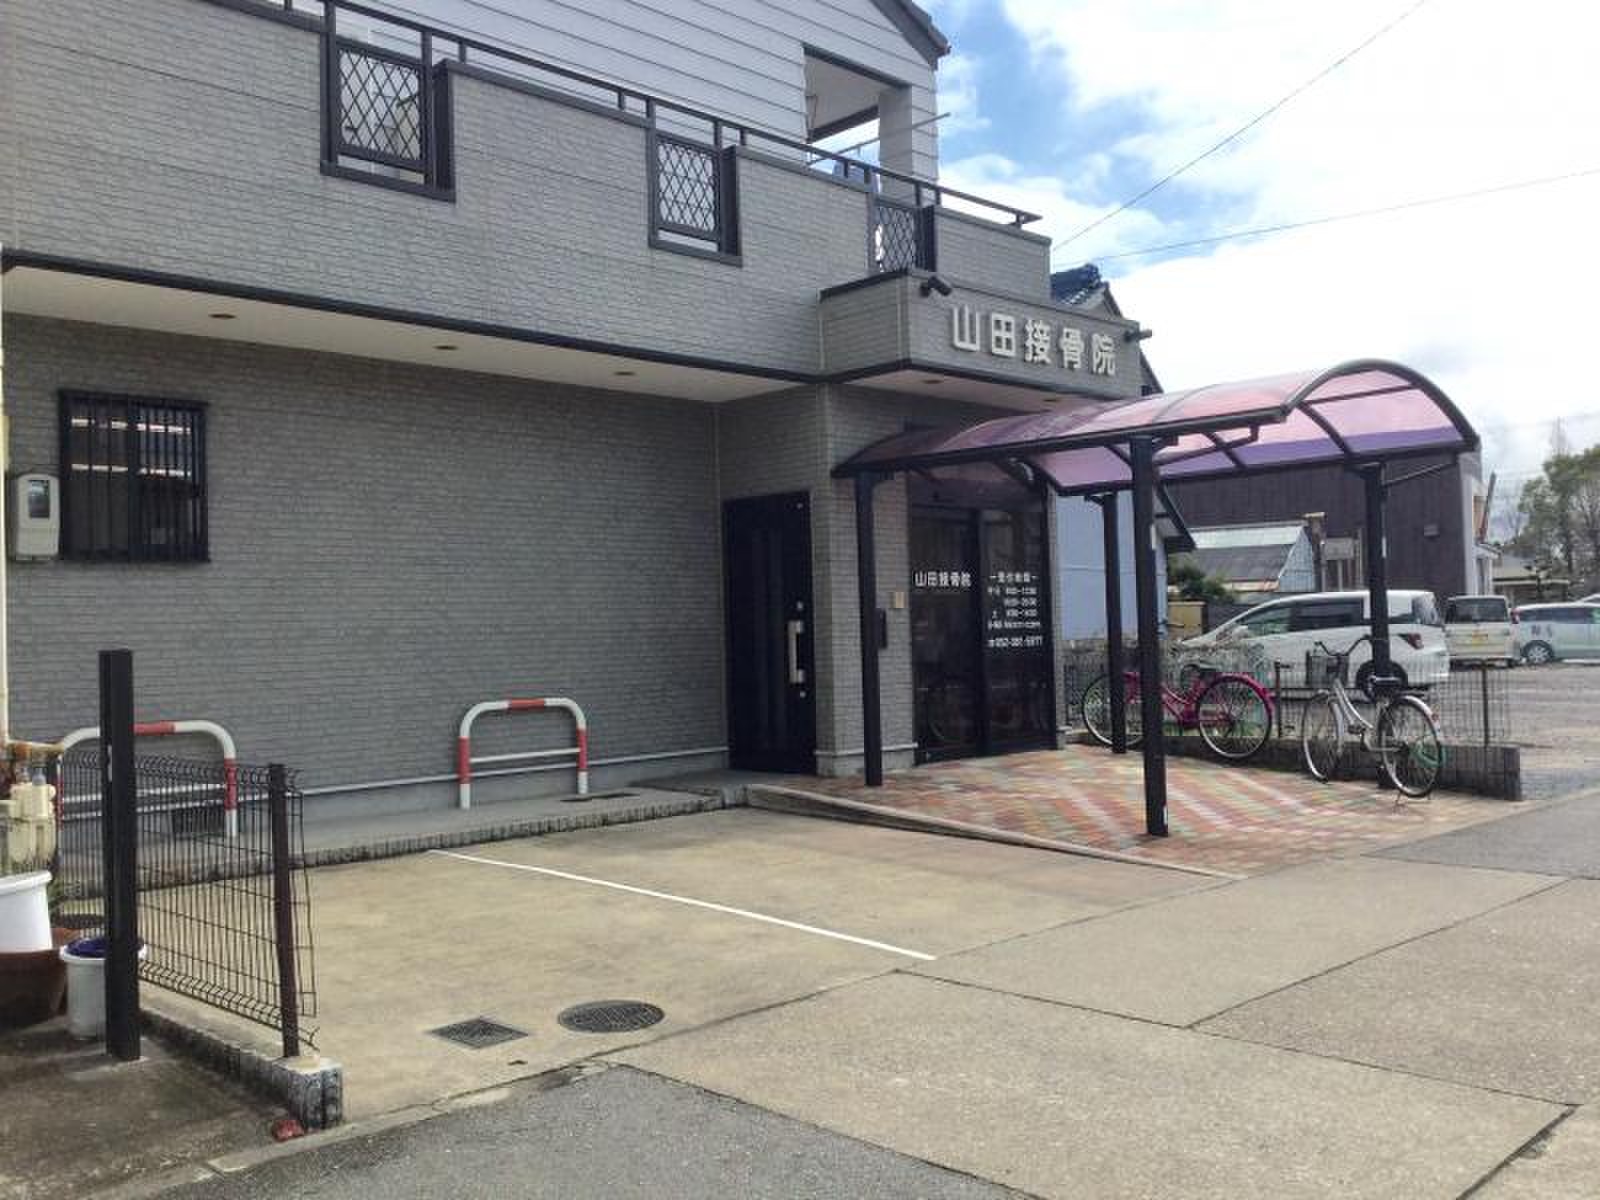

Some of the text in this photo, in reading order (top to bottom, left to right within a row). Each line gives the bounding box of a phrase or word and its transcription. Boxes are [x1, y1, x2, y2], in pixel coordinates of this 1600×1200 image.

[952, 305, 1116, 375] 山田接骨院
